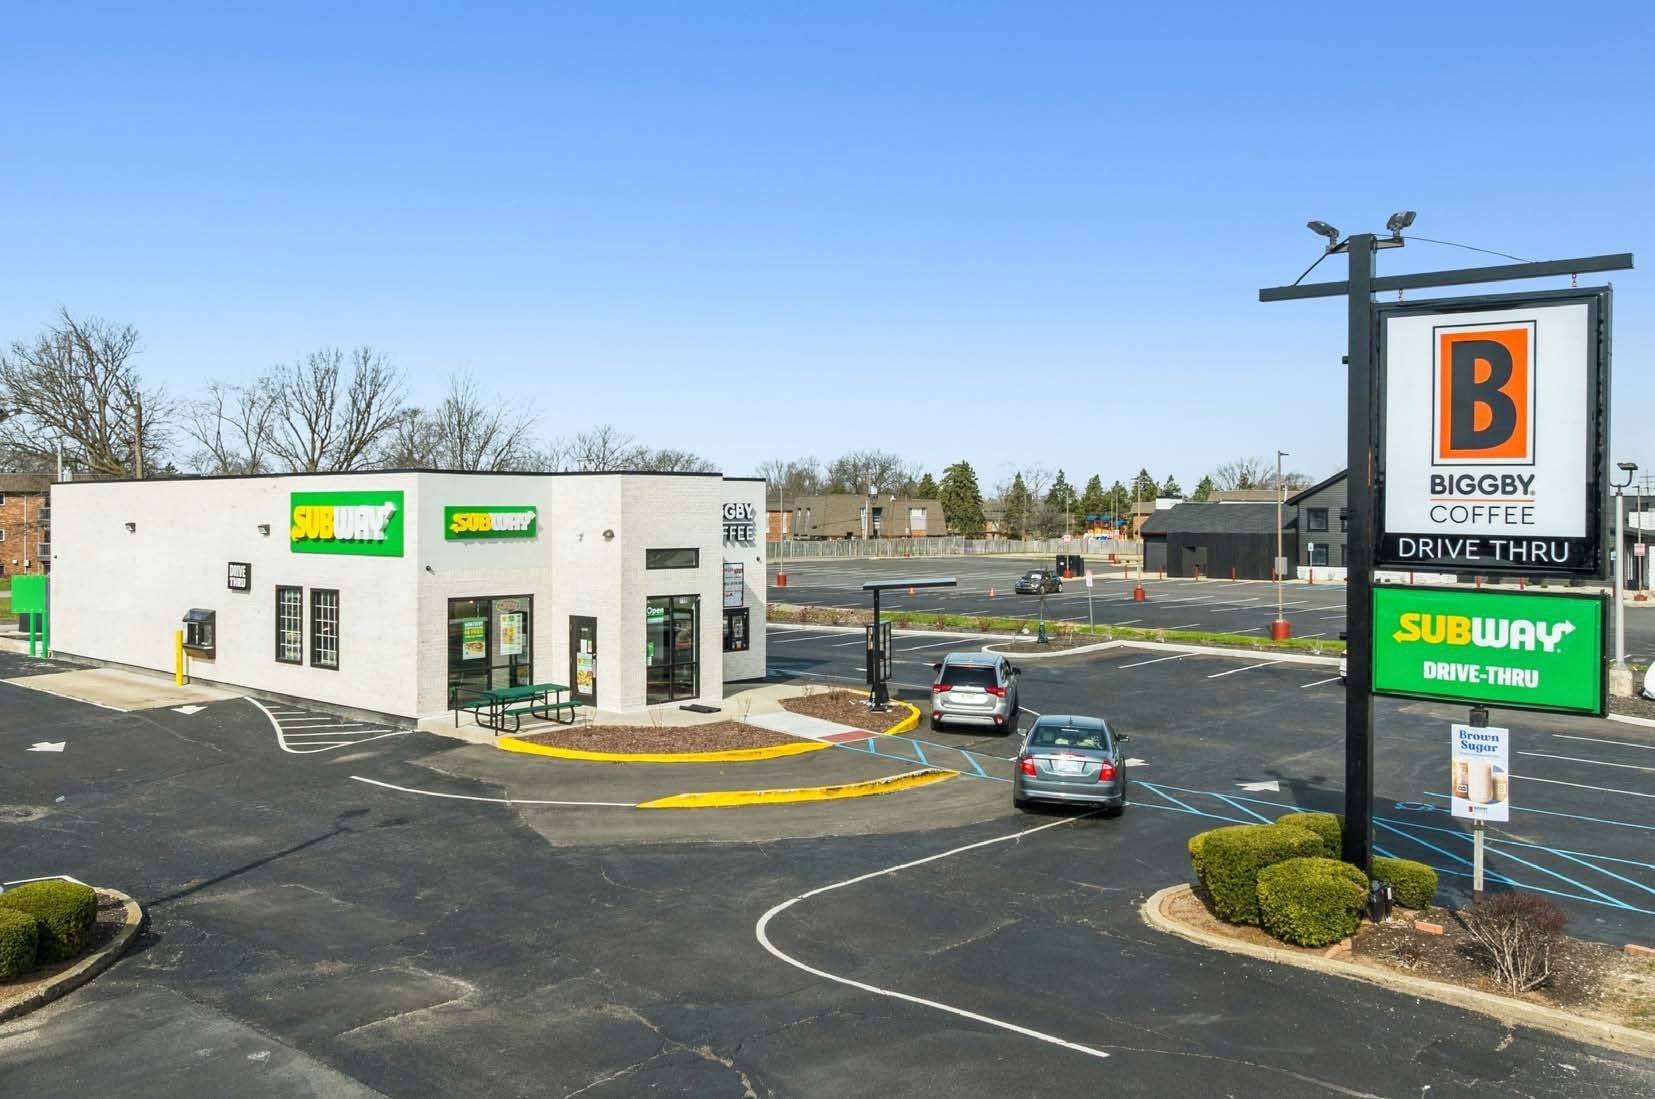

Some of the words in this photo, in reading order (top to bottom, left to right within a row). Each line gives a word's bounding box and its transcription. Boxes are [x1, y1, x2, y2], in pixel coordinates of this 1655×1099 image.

[1450, 340, 1517, 450] B
[1430, 474, 1535, 496] BIGGBY
[291, 501, 397, 541] SUBWAY
[723, 503, 753, 519] GBY
[1430, 505, 1535, 525] COFFEE
[449, 511, 536, 533] SUBWAY
[1399, 538, 1480, 559] DRIVE
[1489, 540, 1569, 563] THRU
[229, 564, 246, 577] DRIVE
[229, 577, 245, 588] THRU
[647, 607, 664, 616] Open
[1392, 612, 1576, 653] SUBWAY
[1423, 661, 1539, 688] DRIVE-THRU
[1459, 729, 1500, 742] Brown
[1460, 740, 1498, 753] Sugar
